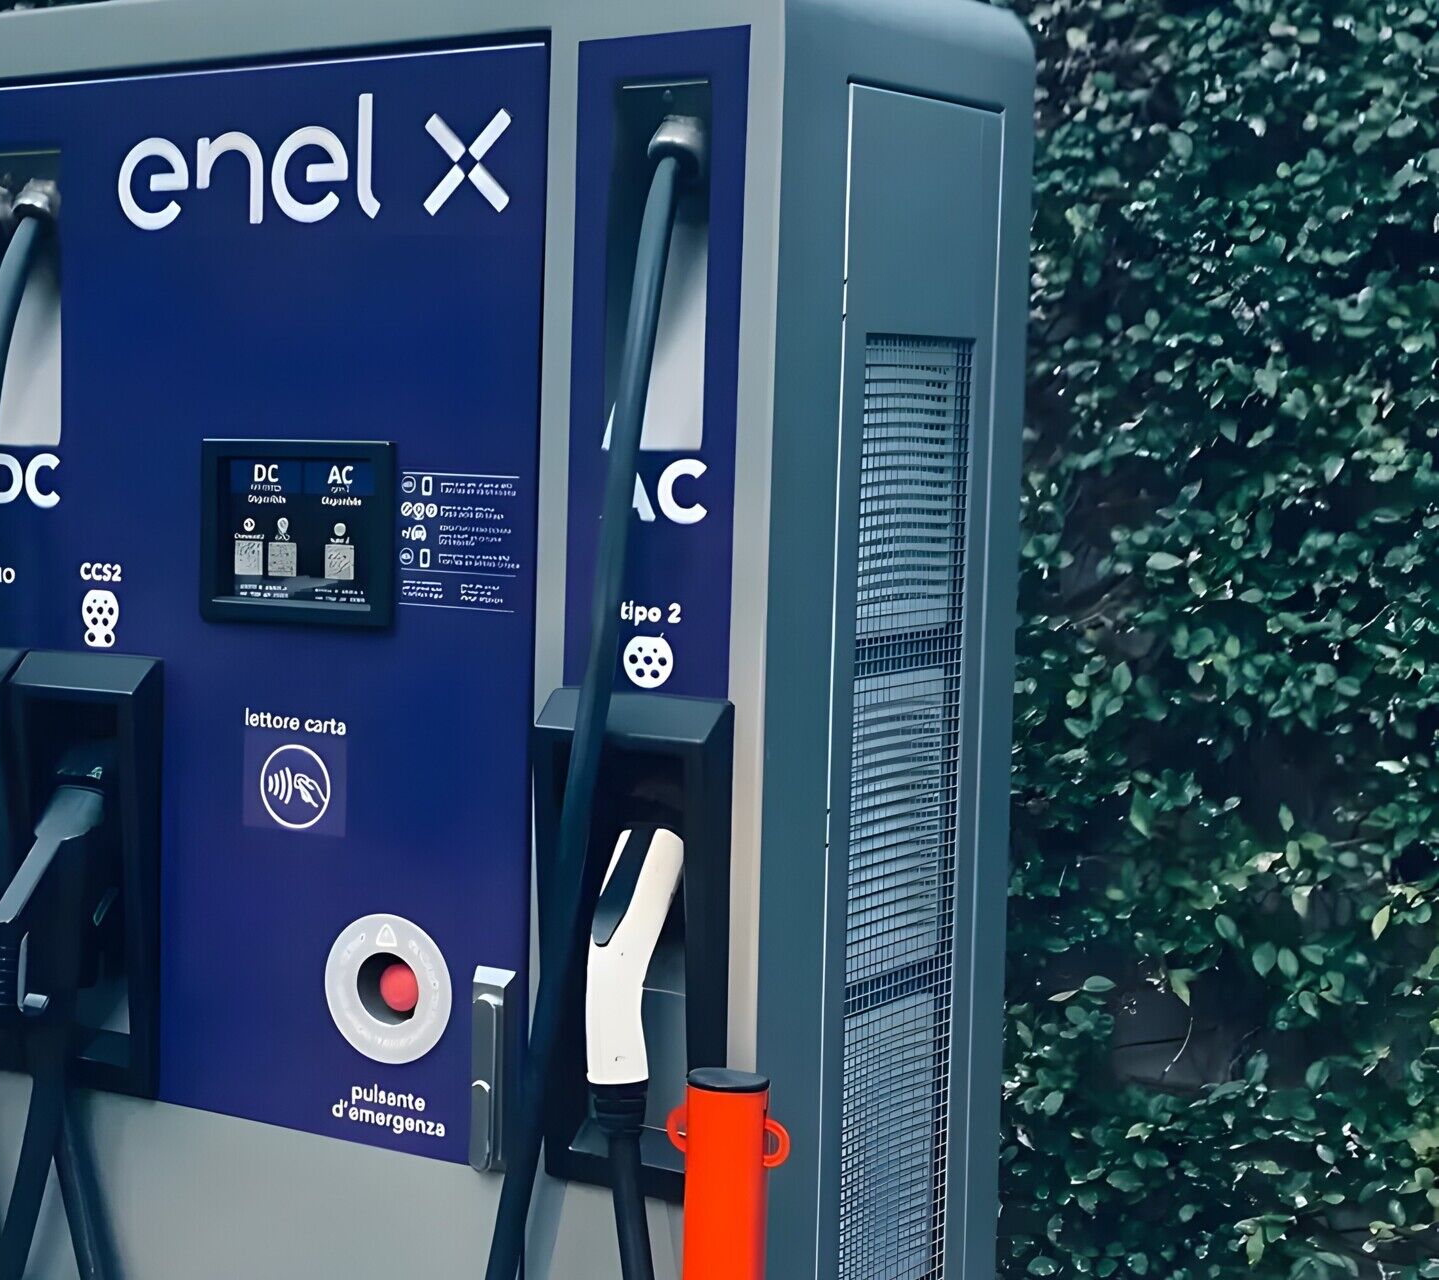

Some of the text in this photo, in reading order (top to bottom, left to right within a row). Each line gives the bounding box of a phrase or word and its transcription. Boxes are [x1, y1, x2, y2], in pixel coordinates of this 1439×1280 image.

[117, 92, 382, 231] enel
[253, 463, 279, 483] DC
[327, 465, 354, 484] AC
[79, 562, 122, 582] CCS2
[620, 600, 682, 627] tipo 2
[244, 707, 347, 736] lettore carta
[351, 1084, 426, 1112] pulsante
[331, 1100, 446, 1138] d'emergenza
